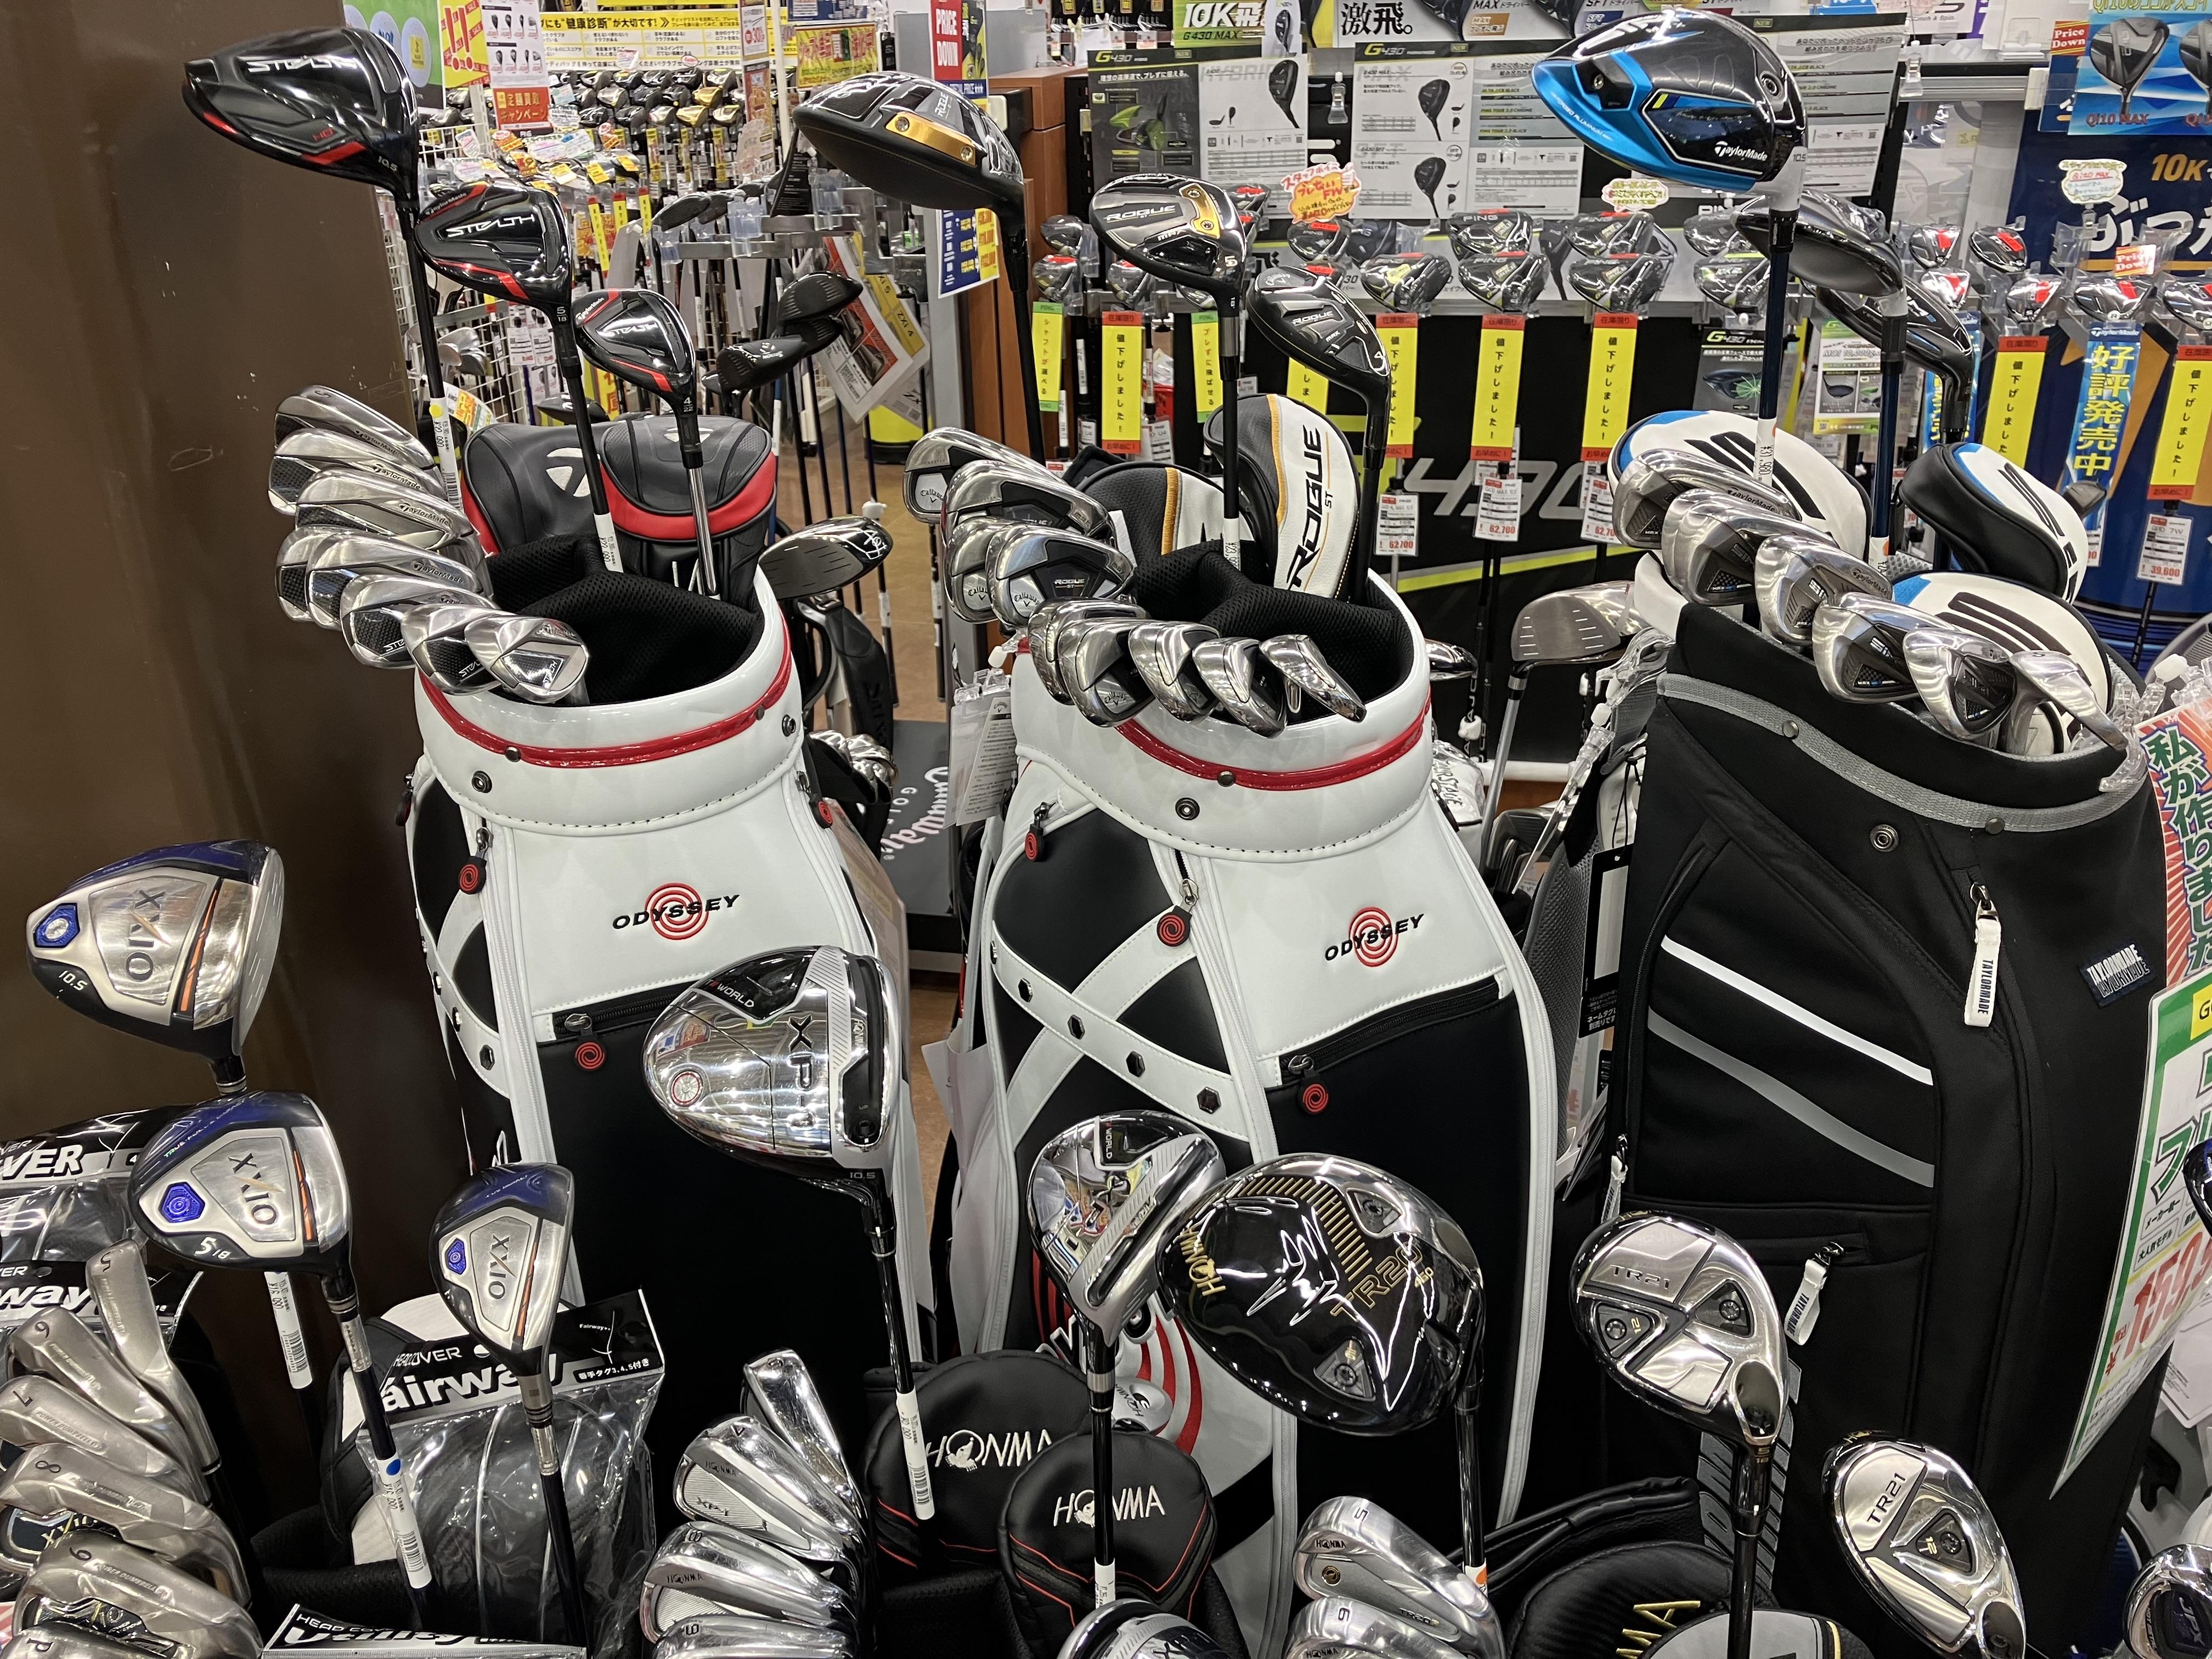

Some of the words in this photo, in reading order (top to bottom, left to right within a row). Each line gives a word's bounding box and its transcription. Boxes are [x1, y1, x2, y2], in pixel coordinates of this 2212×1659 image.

[936, 8, 958, 35] PRICE
[1183, 31, 1210, 41] G430
[1214, 30, 1239, 40] MAX
[2052, 38, 2085, 49] Down
[2054, 29, 2085, 39] Price
[936, 41, 959, 66] DOWN
[1095, 51, 1132, 63] G430
[1364, 43, 1406, 55] G430
[247, 54, 360, 74] STEALTH
[934, 91, 949, 118] ROGUE
[2086, 114, 2117, 127] Qi10
[2119, 113, 2150, 126] MAX
[1714, 140, 1768, 163] TaylorMade
[377, 155, 398, 172] 10.5
[1323, 188, 1342, 200] FW
[1103, 204, 1176, 223] ROGUE
[1463, 214, 1498, 222] PING
[447, 213, 535, 238] STEALTH
[1224, 255, 1238, 268] 5
[556, 306, 566, 315] 5
[1108, 314, 1135, 323] 在庫限り
[1292, 310, 1334, 325] ROGUE
[1600, 315, 1632, 325] 在庫限り
[1488, 318, 1518, 326] 在庫限り
[1325, 330, 1341, 343] MAX
[1706, 330, 1746, 343] G430
[1041, 318, 1049, 395] シャフトが選べる
[1374, 351, 1386, 360] 4
[1116, 333, 1126, 433] 値下げしました!
[1490, 337, 1506, 439] 値下げしました!
[1600, 336, 1618, 440] 値下げしました!
[682, 396, 692, 405] 4
[683, 404, 694, 413] 22
[2073, 345, 2136, 478] 好評発売中
[2171, 369, 2202, 478] 値下げしました!
[372, 462, 421, 490] TaylorMade
[1286, 424, 1323, 590] ROGUE
[1324, 491, 1334, 509] ST
[1726, 487, 1776, 514] TaylorMade
[398, 502, 449, 526] TaylorMade
[1489, 525, 1516, 534] 62,700
[413, 560, 464, 585] TaylorMade
[2151, 565, 2181, 577] 39,600
[1851, 567, 1888, 596] TaylorMade
[1013, 592, 1041, 606] Callaway
[611, 894, 741, 931] ODYSSEY
[125, 889, 165, 981] XXIO
[1324, 912, 1425, 962] ODYSSEY
[2086, 943, 2142, 982] TAYLORMADE
[58, 969, 89, 992] 10.5
[1978, 958, 1994, 1016] TAYLORMADE
[716, 982, 756, 1009] WORLD
[1105, 1127, 1113, 1160] WORLD
[849, 1171, 877, 1181] 10.5
[228, 1152, 278, 1226] XXIO
[194, 1236, 217, 1256] 5
[488, 1233, 511, 1300] XXIO
[1179, 1225, 1227, 1297] HONMA
[1330, 1241, 1423, 1317] TR20
[1610, 1263, 1671, 1291] TR21
[1786, 1293, 1808, 1335] TAYLORMADE
[1629, 1317, 1640, 1334] 12
[13, 1390, 34, 1408] 7
[1757, 1447, 1771, 1455] 5
[35, 1460, 61, 1474] 8
[704, 1460, 737, 1477] HONMA
[1866, 1471, 1908, 1525] TR21
[1353, 1507, 1369, 1522] 5
[687, 1529, 703, 1543] 8
[1315, 1538, 1347, 1549] HONMA
[1925, 1536, 1938, 1555] 12
[666, 1572, 704, 1584] HONMA
[296, 1612, 345, 1633] HEAD
[1338, 1606, 1350, 1622] 6
[26, 1638, 54, 1654] P
